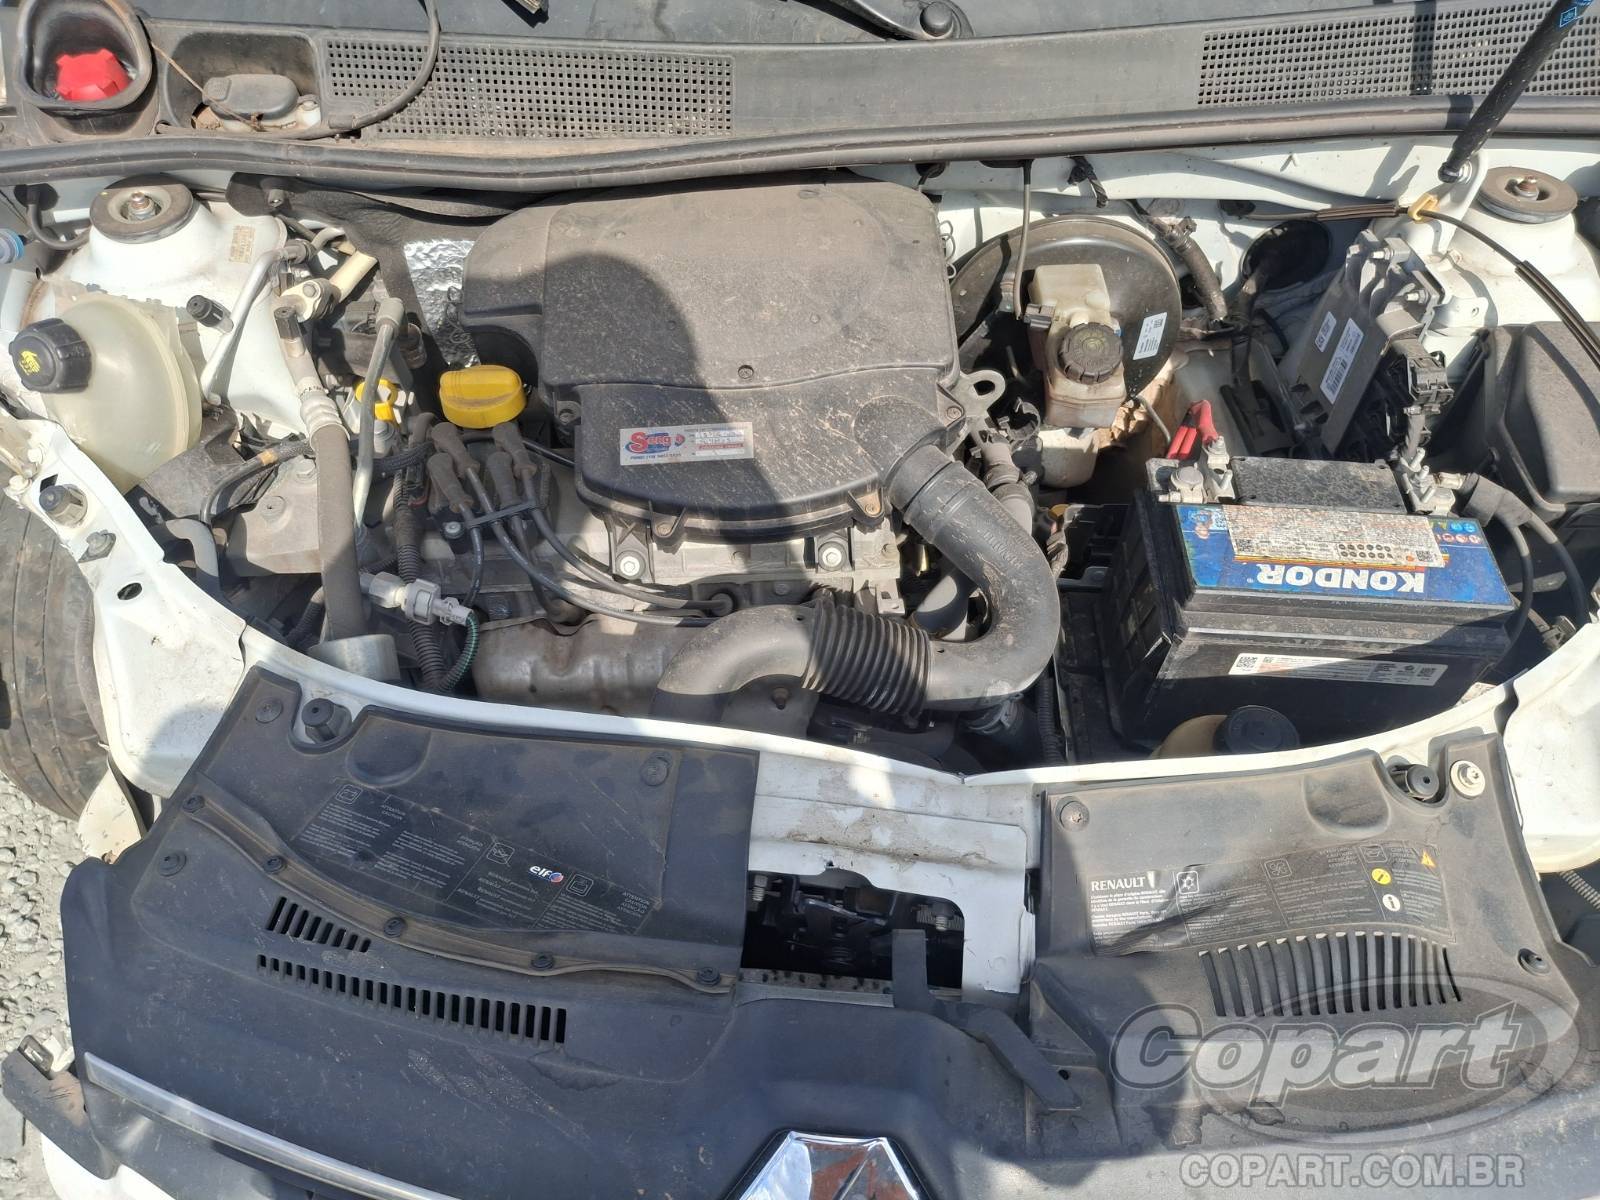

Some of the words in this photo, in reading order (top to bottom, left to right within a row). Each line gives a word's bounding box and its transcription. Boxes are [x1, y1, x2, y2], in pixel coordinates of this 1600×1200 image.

[1256, 564, 1425, 593] KONDOR
[529, 864, 553, 878] elf
[1091, 876, 1146, 891] RENAULT
